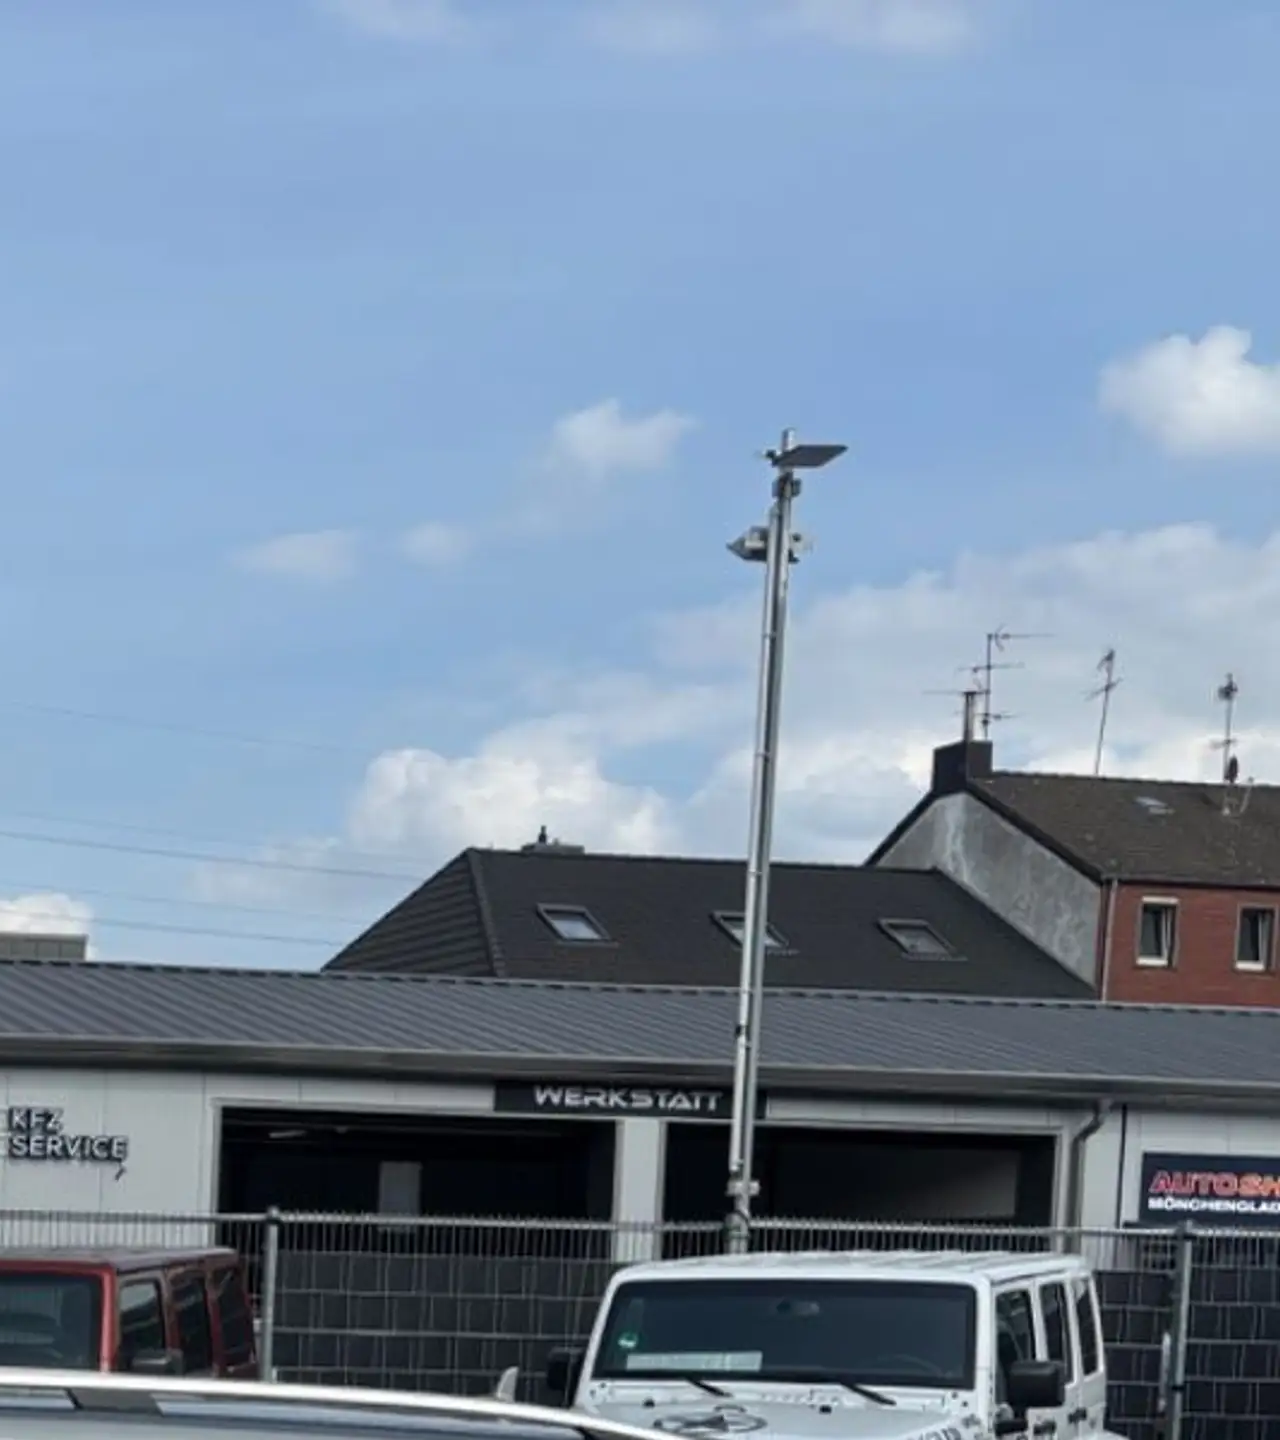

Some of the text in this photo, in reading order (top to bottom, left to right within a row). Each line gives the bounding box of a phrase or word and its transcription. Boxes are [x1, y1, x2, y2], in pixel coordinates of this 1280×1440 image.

[534, 1084, 724, 1112] WERKSTATT
[8, 1106, 64, 1135] KFZ
[8, 1134, 129, 1162] SERVICE
